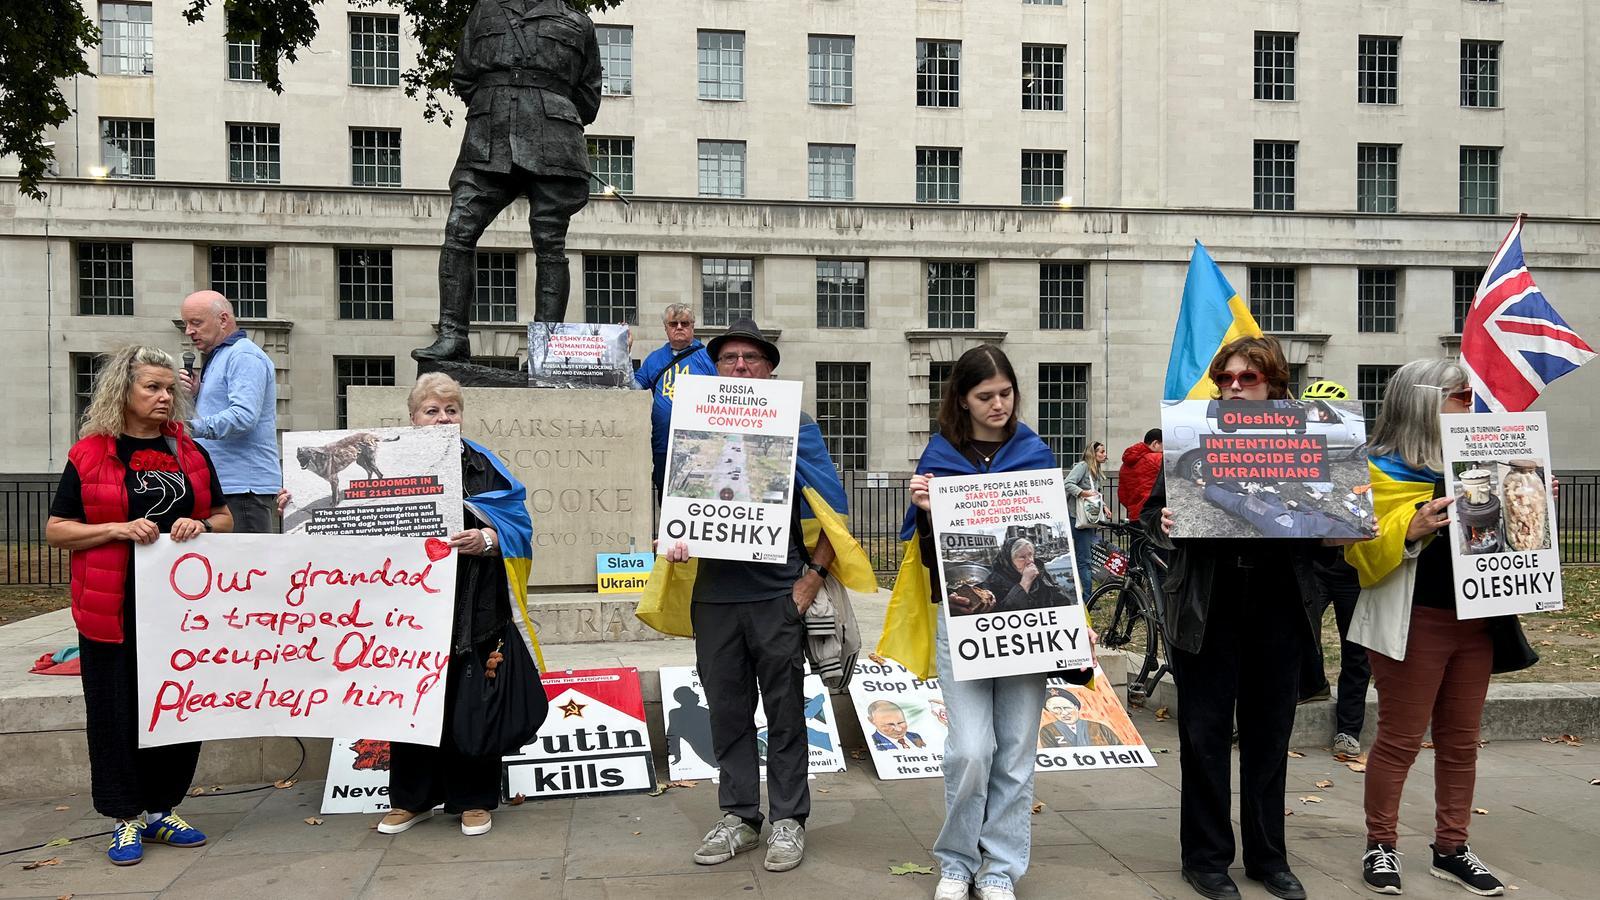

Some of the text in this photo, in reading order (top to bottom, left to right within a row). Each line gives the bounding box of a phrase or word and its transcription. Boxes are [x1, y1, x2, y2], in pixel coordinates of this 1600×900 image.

[719, 384, 754, 395] RUSSIA
[707, 394, 768, 406] IS SHELLING
[696, 405, 777, 418] HUMANITARIAN
[708, 416, 763, 428] CONVOYS
[1223, 412, 1299, 427] Oleshky.
[480, 419, 623, 438] MARSHAL
[1206, 438, 1322, 449] INTENTIONAL
[498, 449, 608, 469] SCOUNT
[1206, 453, 1322, 463] GENOCIDE OF
[1212, 467, 1320, 478] UKRAINIANS
[351, 478, 417, 488] HOLODOMOR
[983, 482, 1011, 491] PEOPLE
[1030, 479, 1053, 487] BEING
[394, 486, 443, 495] CENTURY
[965, 489, 1030, 500] STARVED AGAIN.
[530, 488, 633, 513] OOKE
[954, 501, 988, 509] AROUND
[379, 512, 419, 520] courgettes
[688, 503, 764, 521] GOOGLE
[972, 508, 986, 516] 180
[950, 512, 1052, 527] ARE TRAPPED BY RUSSIANS.
[536, 532, 630, 546] CVO DSO
[666, 519, 782, 546] OLESHKY
[947, 536, 995, 547] ОЛЕШКИ
[607, 557, 644, 568] Slava
[1476, 554, 1538, 572] GOOGLE
[170, 553, 440, 606] Our grandad
[601, 577, 648, 589] Ukrain
[1463, 571, 1555, 600] OLESHKY
[180, 599, 423, 635] is trapped in
[975, 611, 1057, 632] GOOGLE
[959, 628, 1079, 660] OLESHKY
[170, 637, 325, 671] occupied
[852, 664, 893, 676] Stop
[863, 680, 907, 693] Stop
[893, 753, 944, 763] Time is
[1036, 750, 1144, 768] Go to Hell
[897, 766, 920, 774] the
[534, 763, 624, 792] kills
[332, 785, 390, 798] Neve
